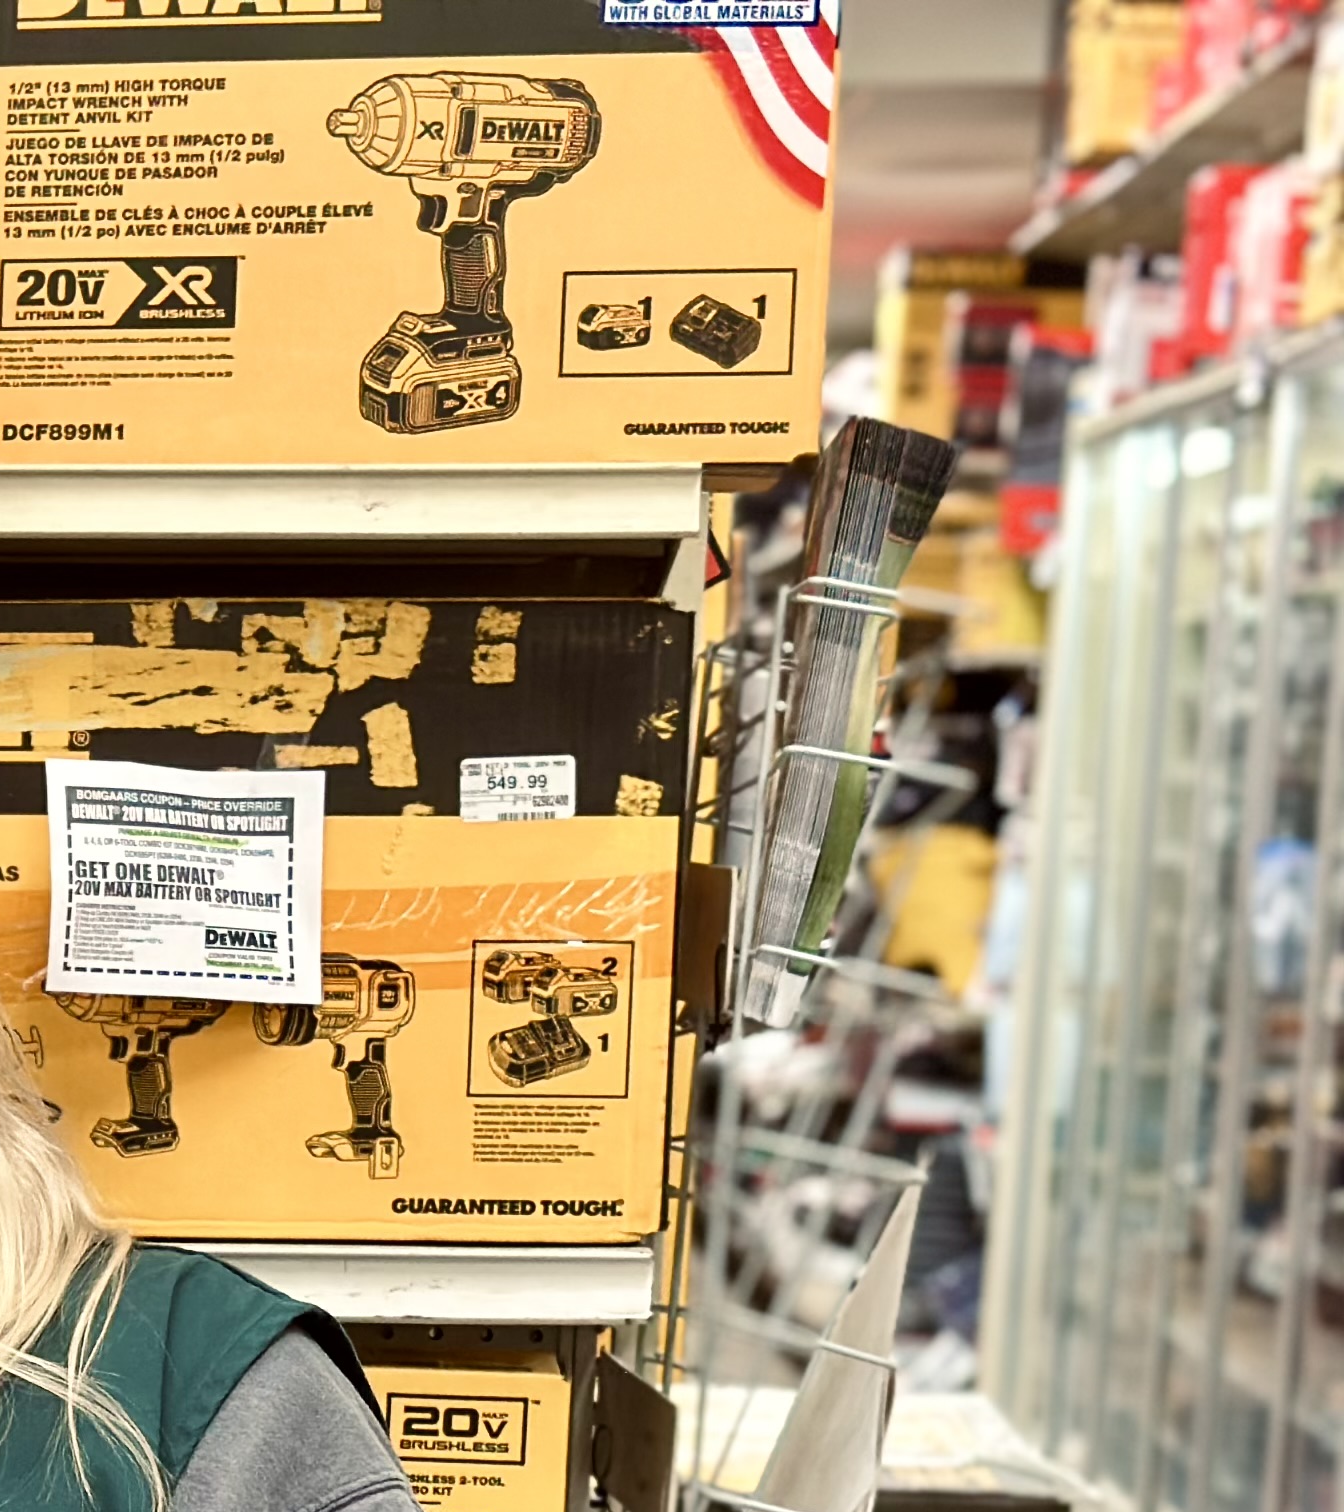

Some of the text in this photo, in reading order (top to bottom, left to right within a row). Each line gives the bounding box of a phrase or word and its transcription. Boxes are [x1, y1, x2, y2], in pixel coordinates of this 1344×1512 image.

[609, 4, 804, 20] WITH GLOBAL MATERIALS
[481, 120, 565, 142] DEWALT
[148, 265, 217, 305] XR
[2, 423, 124, 442] DCF899M1
[623, 422, 725, 436] GUARANTEED
[487, 774, 548, 790] 549.99
[76, 788, 282, 812] BOMGAARS COUPON PRICE OVERRIDE
[75, 860, 109, 880] GET
[115, 862, 152, 883] ONE
[74, 880, 282, 909] 20V MAX BATTERY OR SPOTLIGHT
[205, 928, 278, 950] DEWALT
[602, 957, 618, 977] 2
[598, 1033, 609, 1053] 1
[391, 1198, 536, 1216] GUARANTEED
[400, 1440, 509, 1453] BRUSHLESS
[460, 1476, 505, 1487] 2-TOOL
[433, 1487, 452, 1497] KIT
